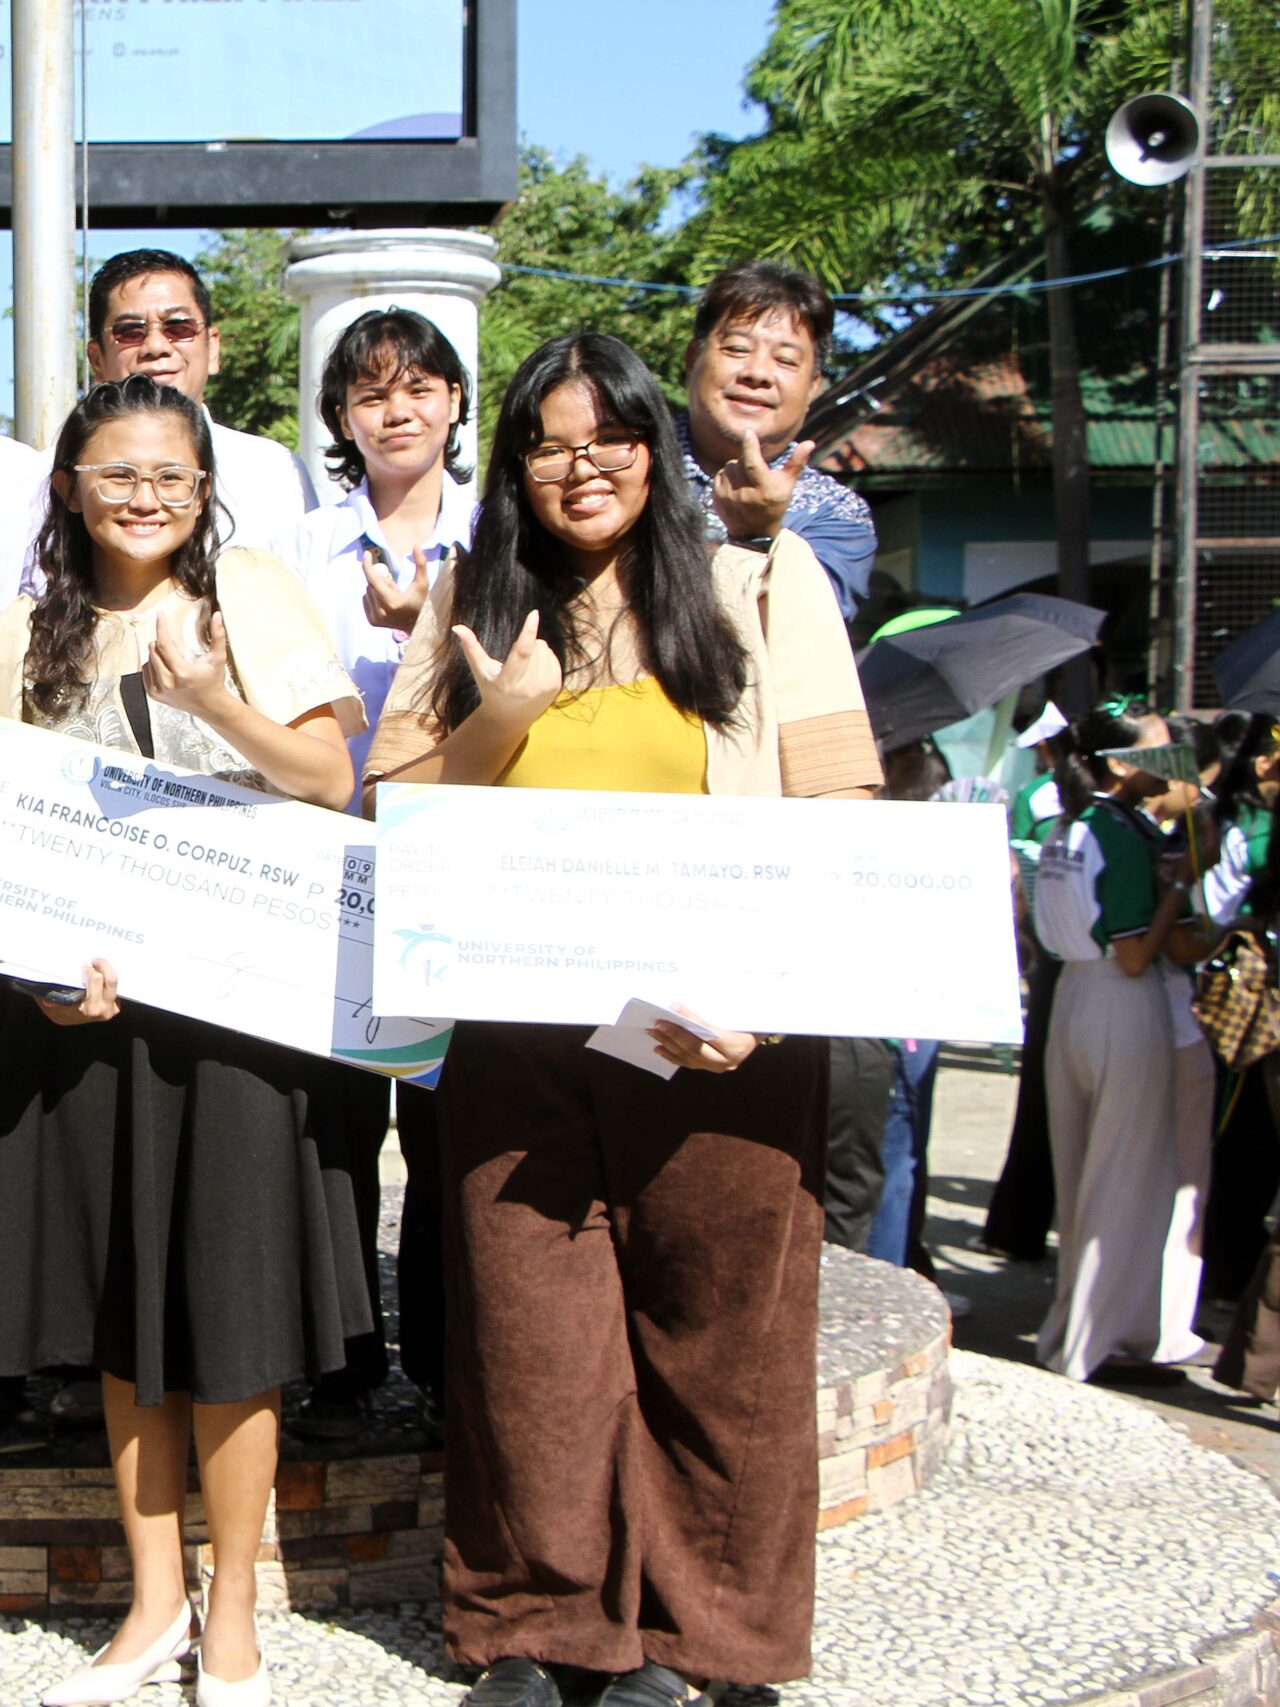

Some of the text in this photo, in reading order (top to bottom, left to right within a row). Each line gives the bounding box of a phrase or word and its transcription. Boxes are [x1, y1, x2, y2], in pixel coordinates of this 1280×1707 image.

[103, 765, 258, 820] UNIVERSITY OF NORTHERN PHILIPPINES
[143, 792, 171, 807] ILOCOS
[16, 793, 45, 815] KIA
[49, 802, 151, 845] FRANCOISE
[153, 833, 170, 852] O.
[259, 863, 300, 887] RSW
[120, 854, 246, 905] THOUSAND
[561, 857, 641, 876] DANIELLE
[753, 864, 791, 880] RSW
[54, 896, 78, 910] OF
[42, 905, 146, 945] PHILIPPINES
[457, 940, 598, 957] UNIVERSITY OF
[457, 953, 679, 973] NORTHERN PHILIPPINES
